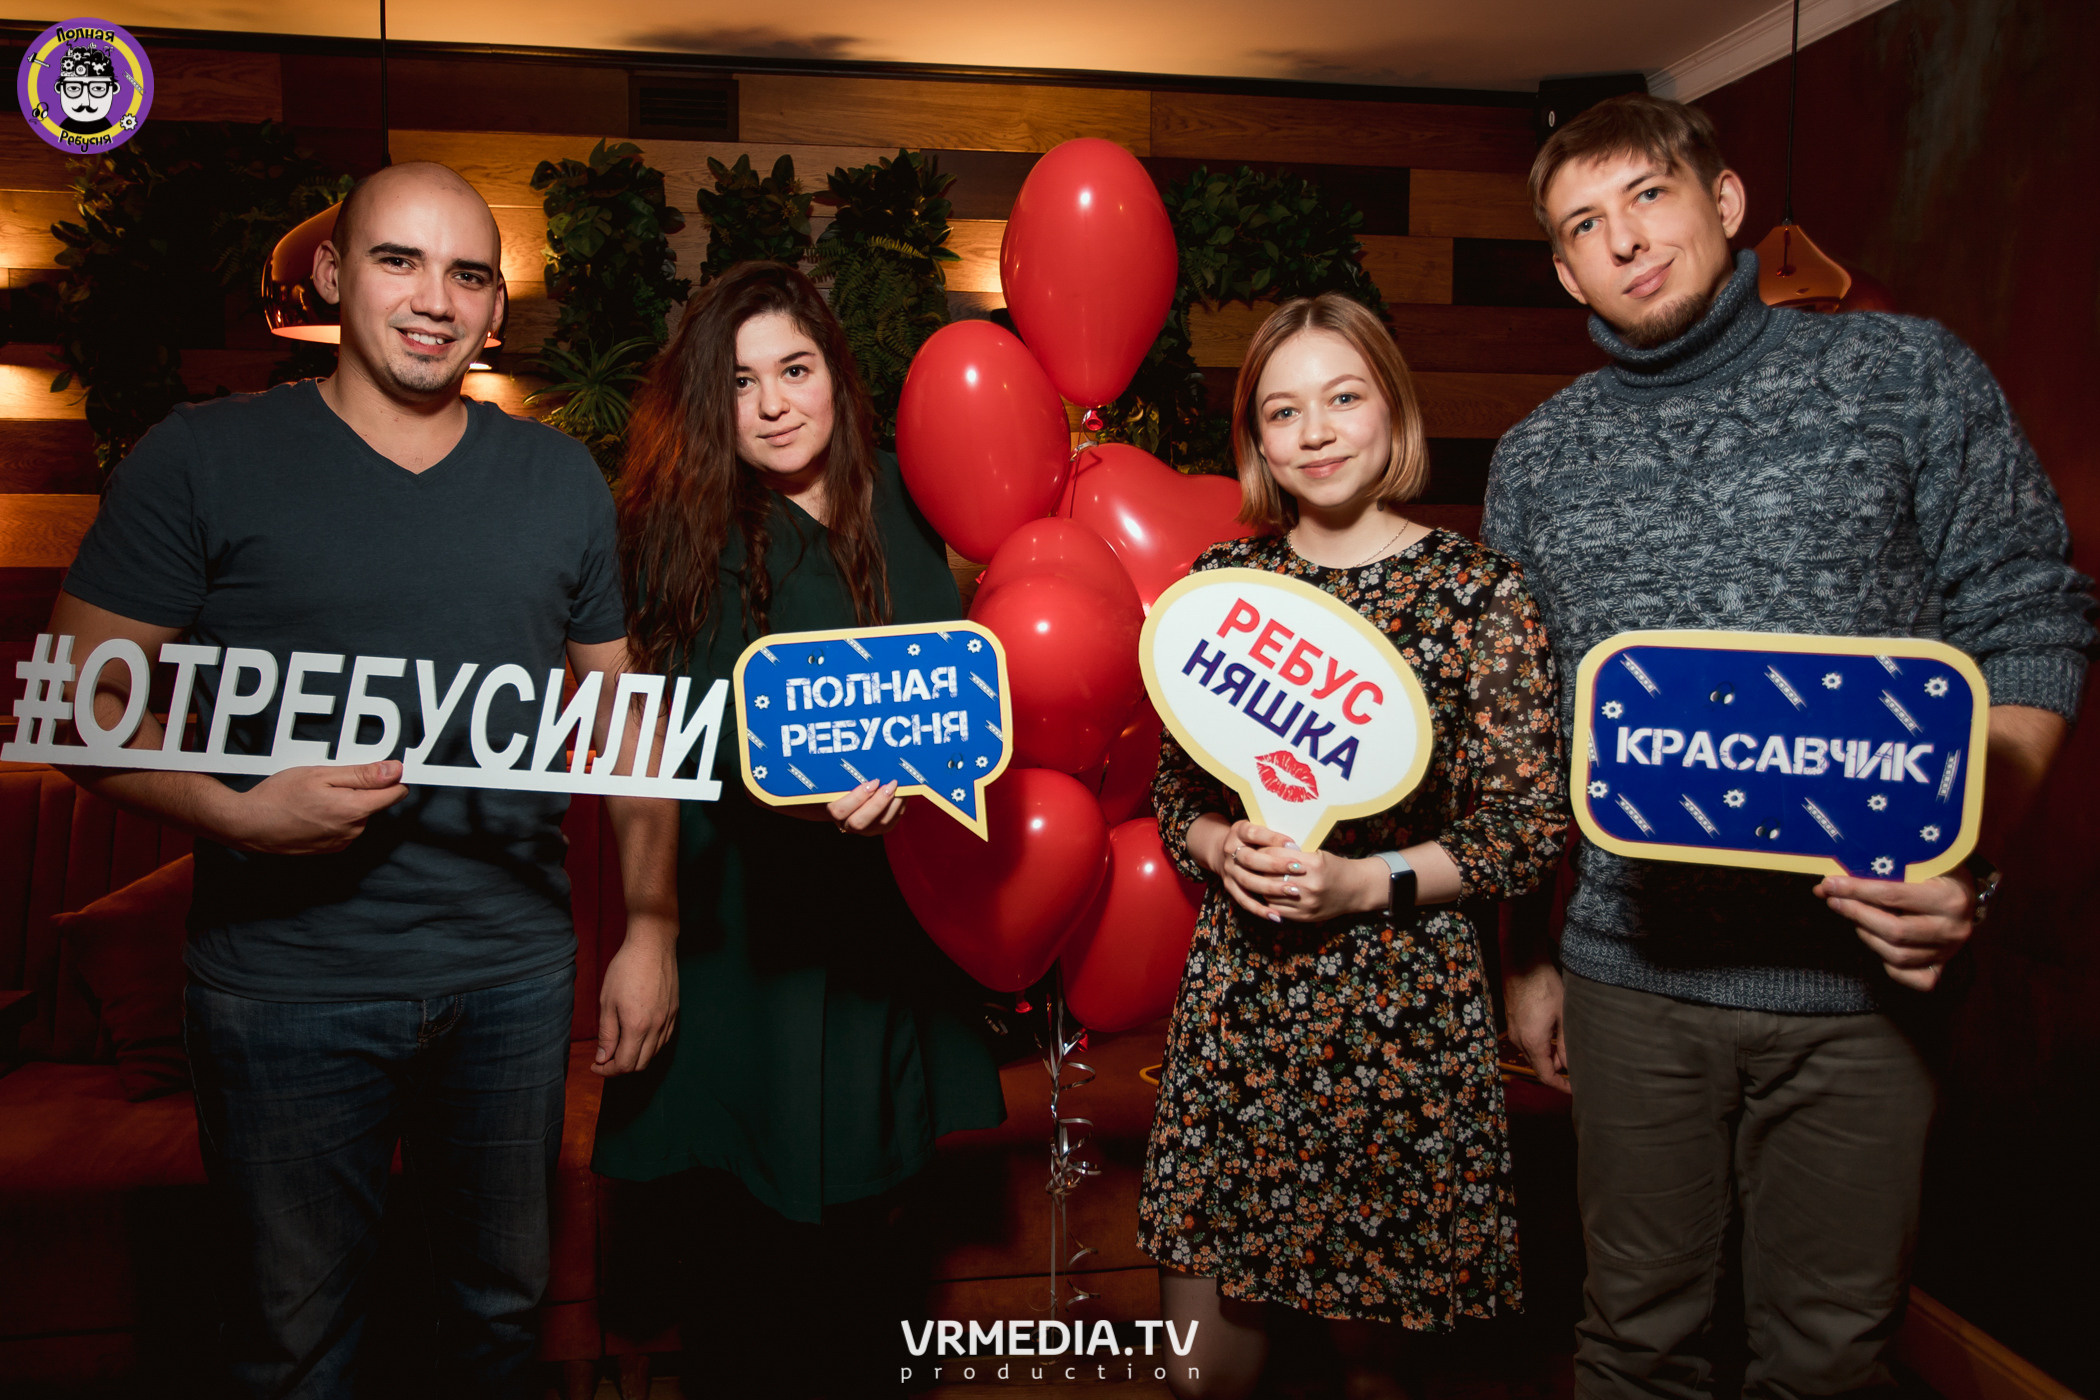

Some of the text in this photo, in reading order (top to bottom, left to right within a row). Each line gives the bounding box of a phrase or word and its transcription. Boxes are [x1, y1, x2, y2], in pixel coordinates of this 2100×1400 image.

[786, 666, 957, 711] ПОЛНАЯ
[1216, 597, 1384, 725] РЕБУС
[0, 633, 730, 801] #ОТРЕБУСИЛИ
[781, 710, 969, 757] РЕБУСНЯ
[1181, 638, 1360, 781] НЯШКА
[1616, 726, 1933, 783] КРАСАВЧИК
